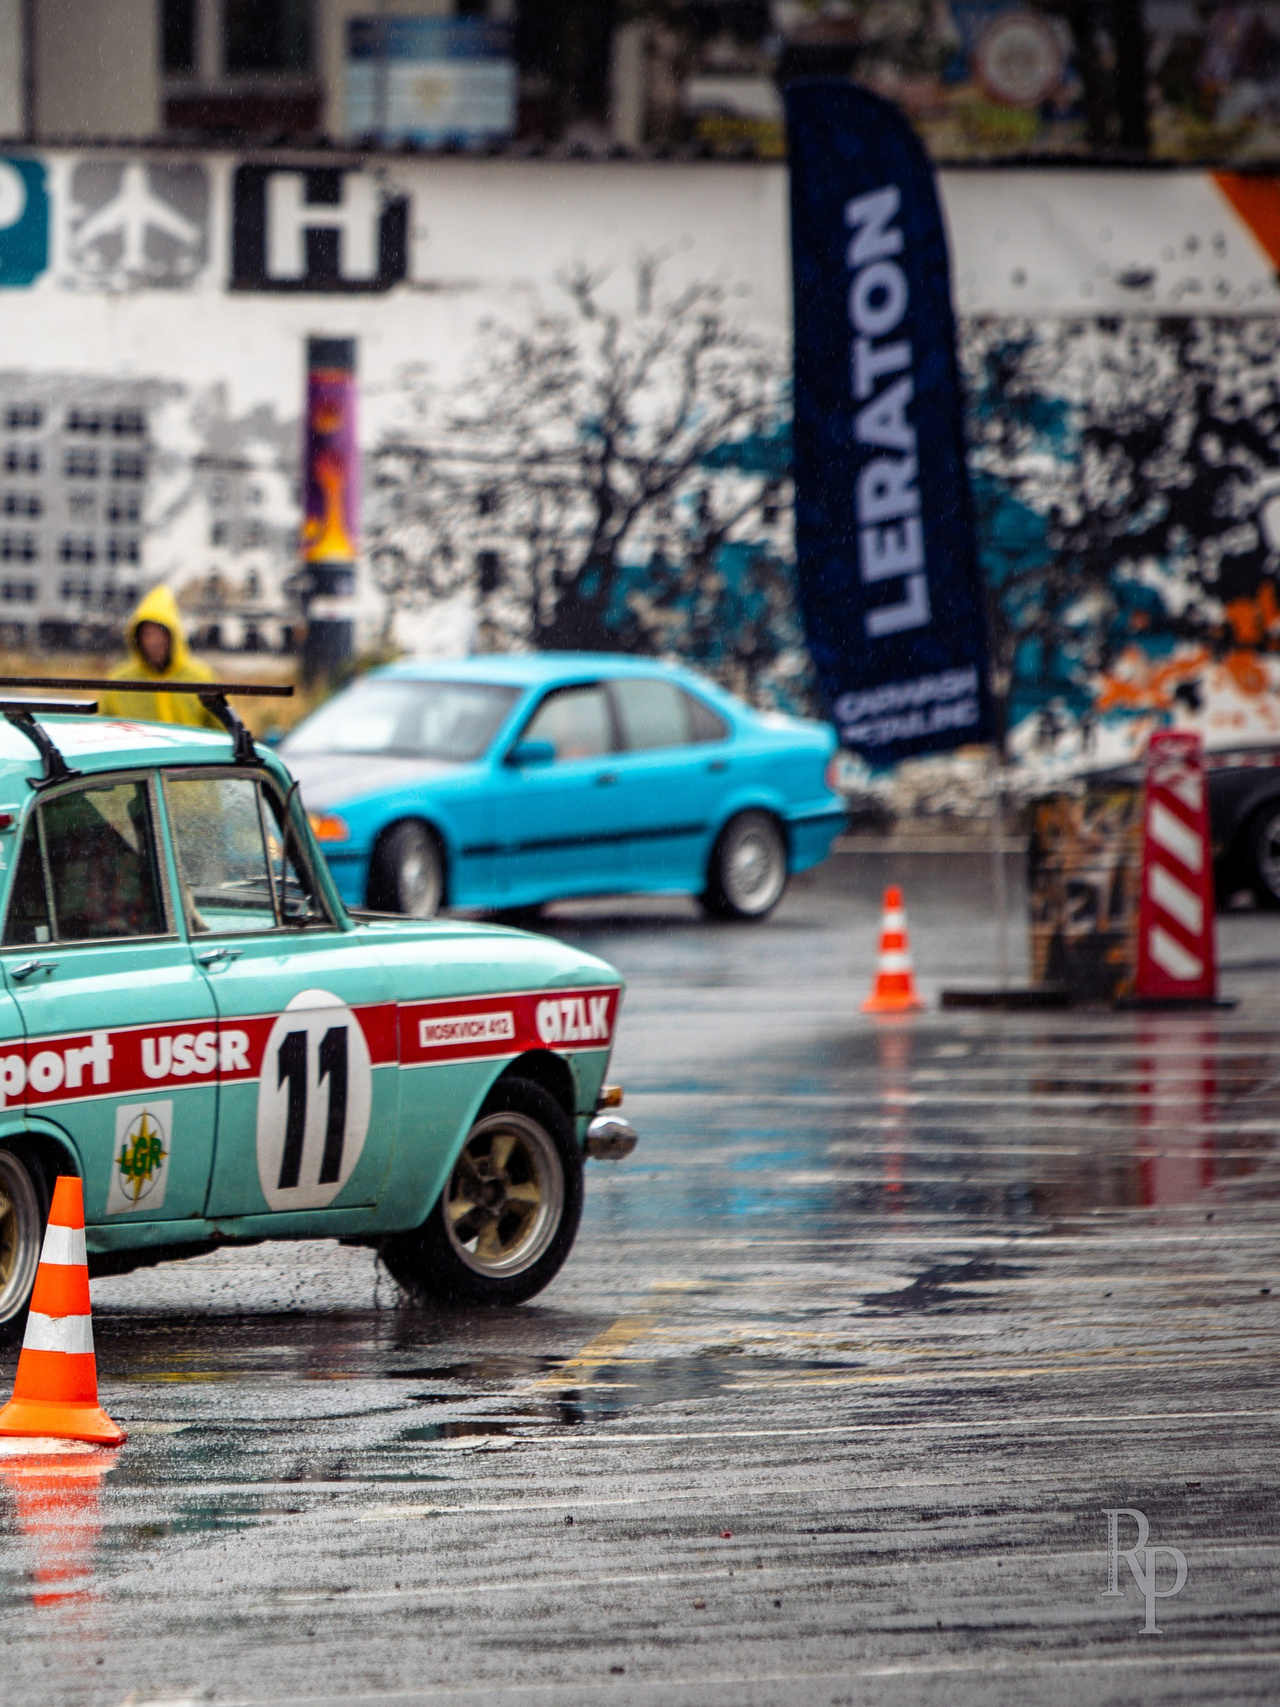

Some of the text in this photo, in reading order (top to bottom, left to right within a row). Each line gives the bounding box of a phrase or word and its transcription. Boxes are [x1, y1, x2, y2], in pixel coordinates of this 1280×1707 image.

[265, 170, 381, 282] H
[844, 184, 931, 638] LERATON
[141, 1030, 251, 1079] USSR
[425, 1018, 509, 1042] MOSKVICH 412
[277, 1025, 349, 1190] 11
[120, 1137, 162, 1177] LGR
